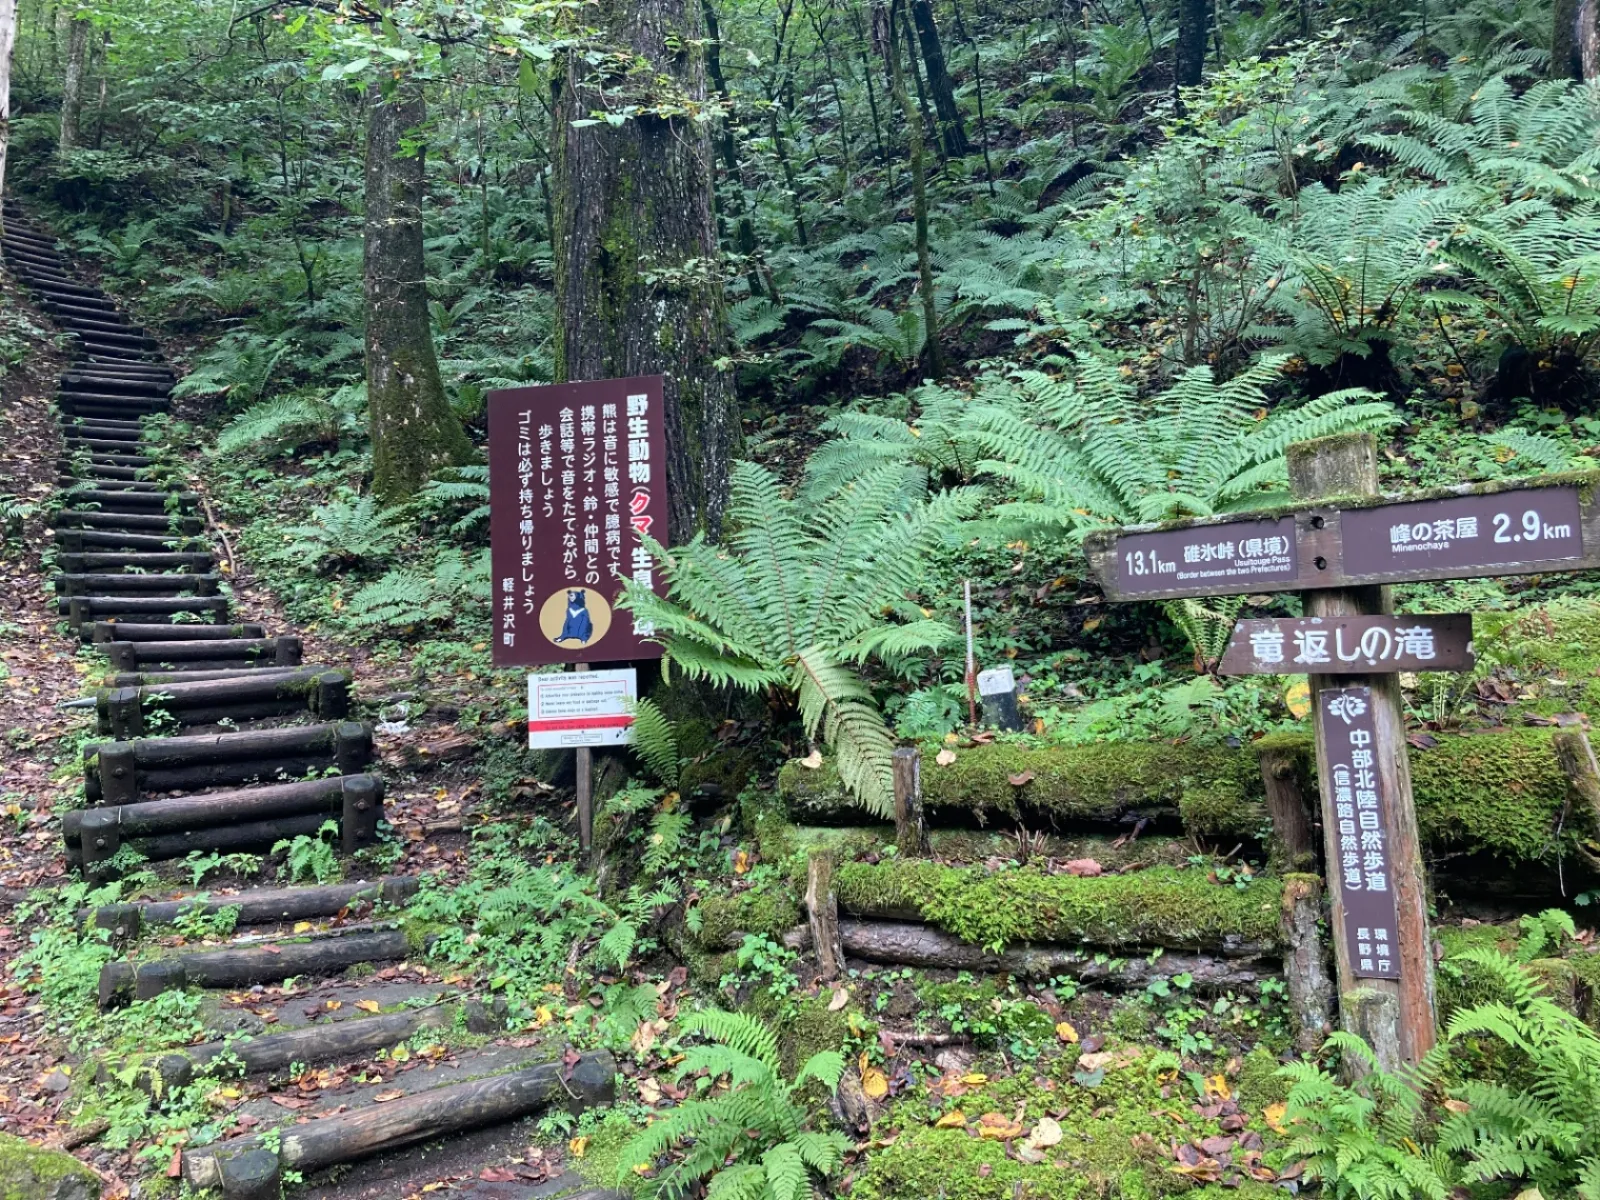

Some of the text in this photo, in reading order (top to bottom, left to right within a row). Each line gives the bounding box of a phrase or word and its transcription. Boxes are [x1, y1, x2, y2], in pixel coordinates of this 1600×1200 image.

[538, 424, 554, 517] 歩きましょう
[518, 410, 535, 614] ゴミは必ず持ち帰りましょう
[1389, 516, 1479, 545] 峰の茶屋
[1271, 555, 1291, 564] Pass
[1391, 541, 1450, 553] Minenochaya
[1176, 571, 1199, 580] (Border
[1199, 568, 1226, 578] between
[1225, 568, 1237, 576] the
[1237, 566, 1250, 575] two
[502, 577, 516, 647] 軽井沢町
[1249, 625, 1437, 664] 竜返しの滝
[1332, 763, 1362, 891] （信濃路自然歩道）
[1349, 728, 1388, 892] 中部北陸自然歩道
[1356, 928, 1374, 971] 長野県
[1373, 928, 1392, 972] 環境庁
